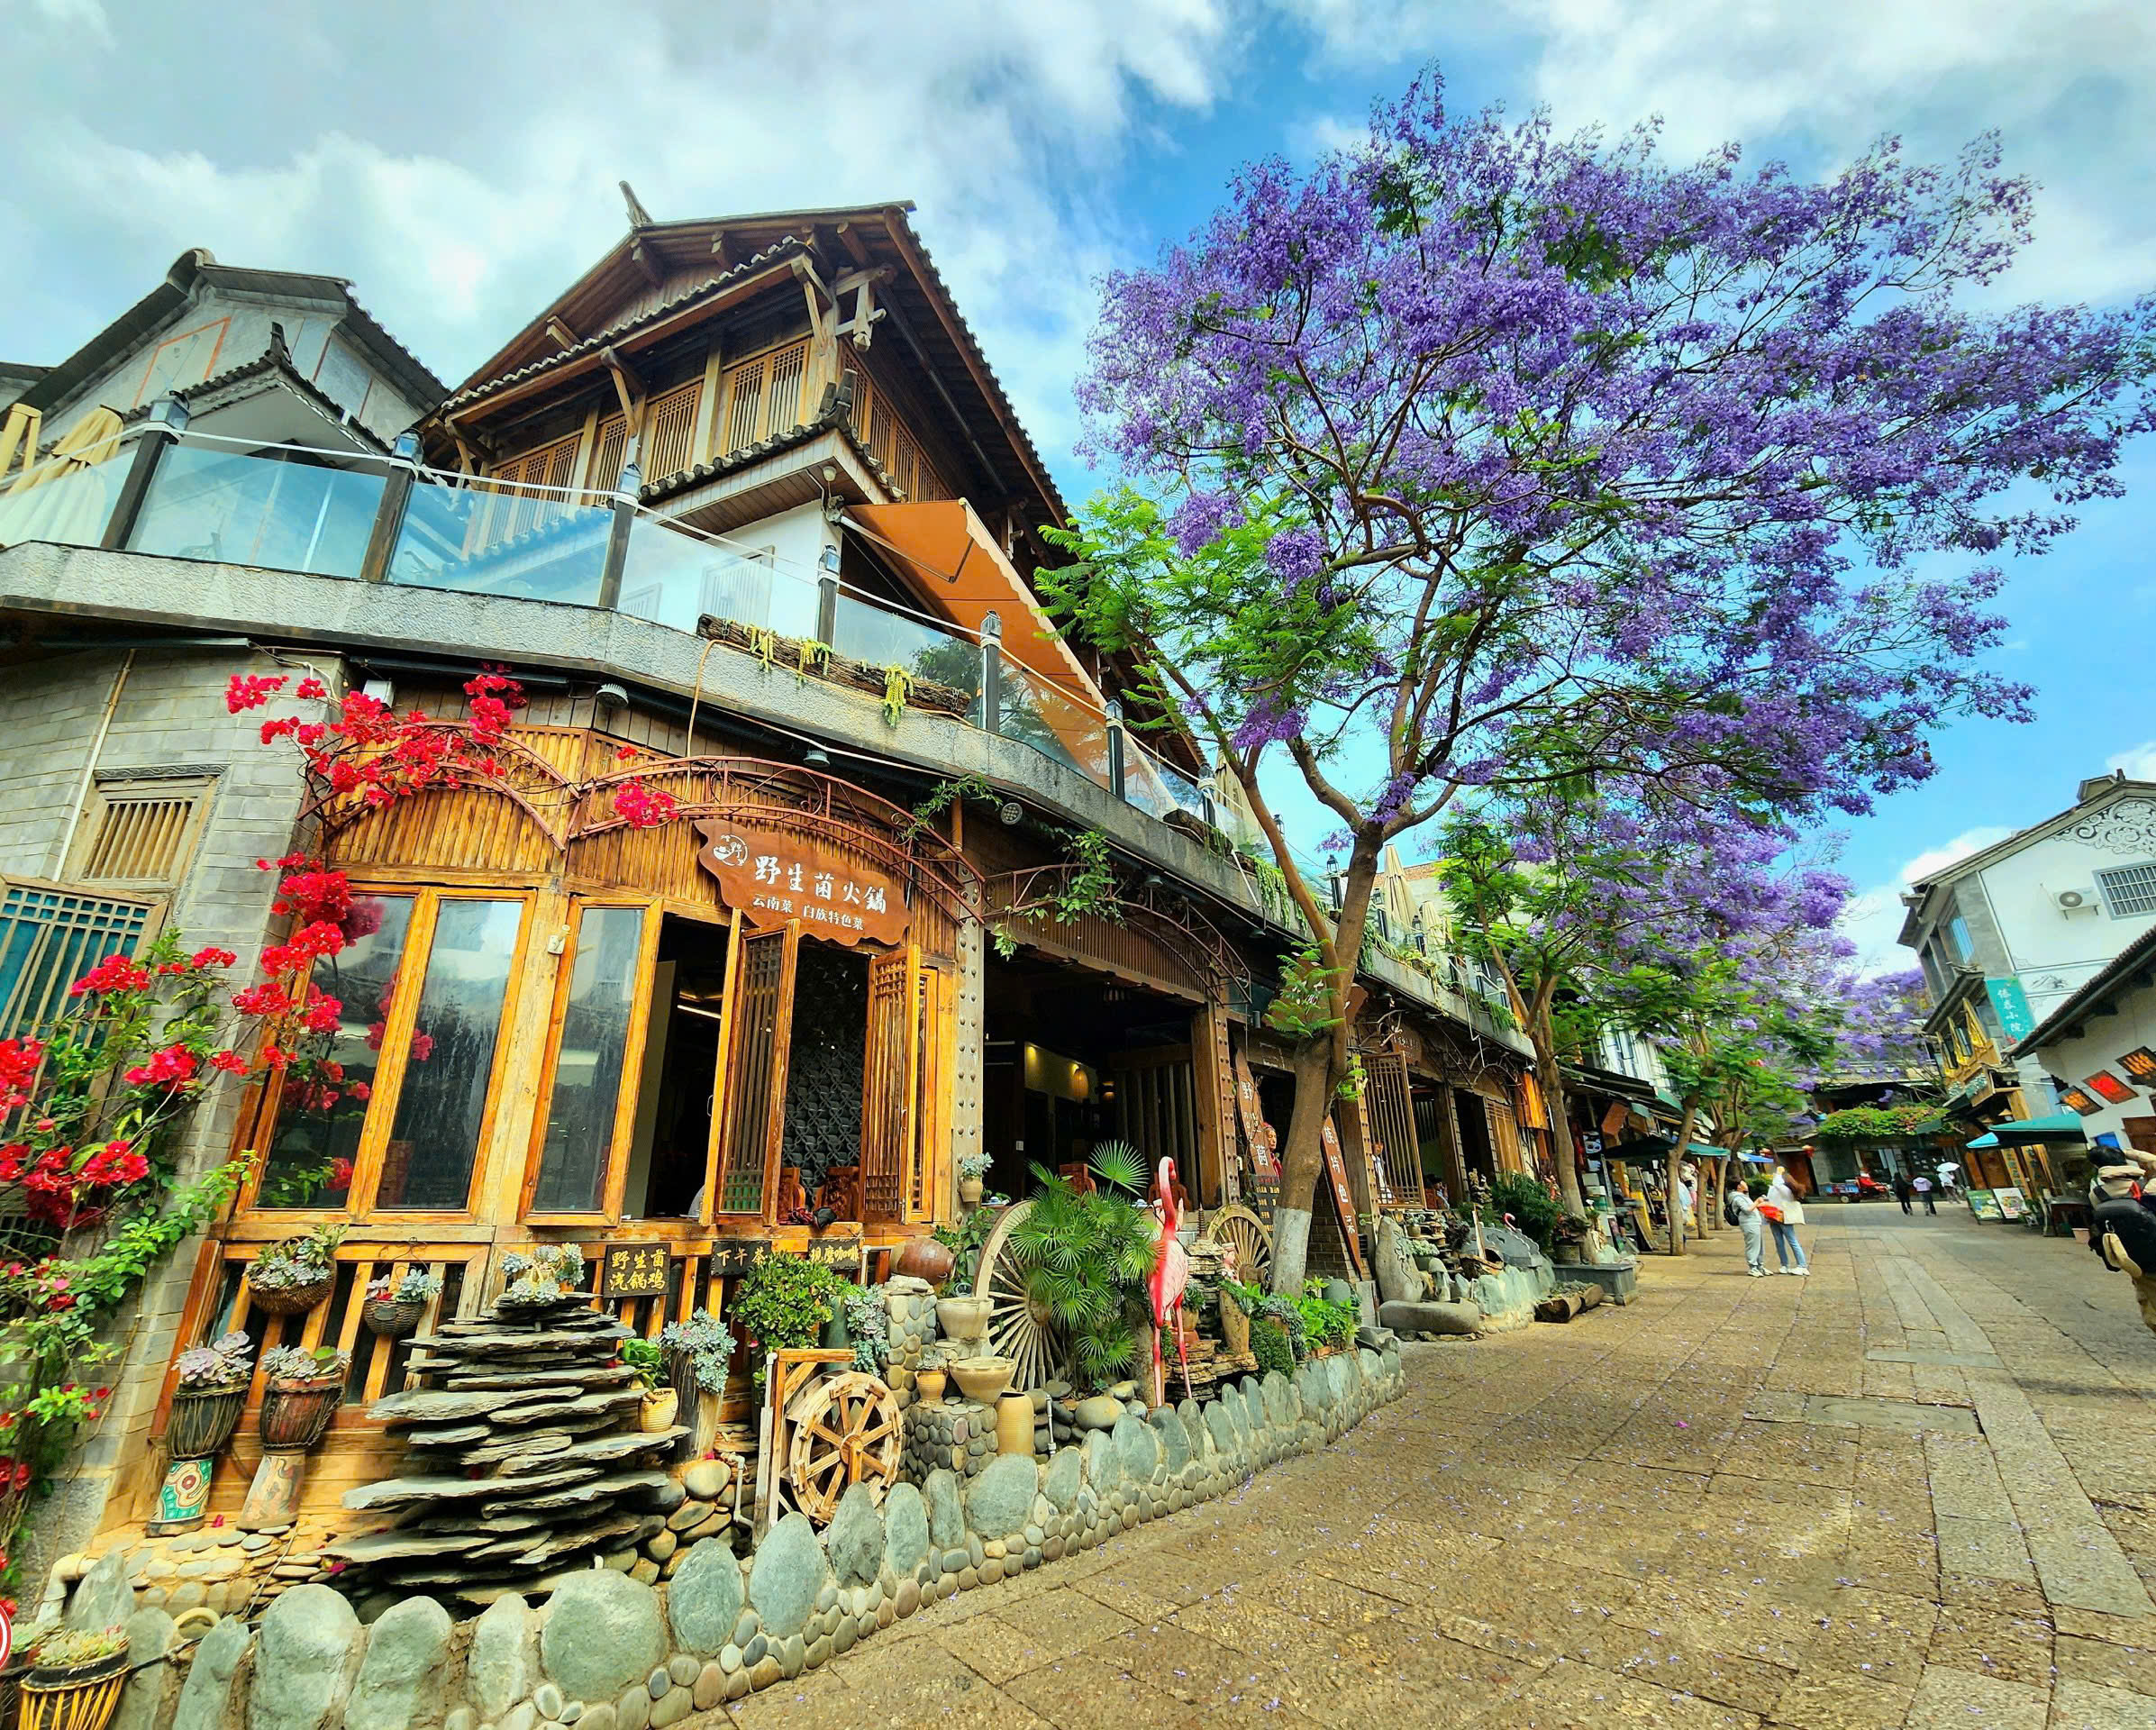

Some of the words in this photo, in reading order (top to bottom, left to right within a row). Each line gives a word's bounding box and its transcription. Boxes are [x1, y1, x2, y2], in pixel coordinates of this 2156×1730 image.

[752, 893, 793, 914] 云南菜
[803, 905, 864, 931] 白族特色菜
[612, 1248, 667, 1270] 野生菌
[716, 1245, 766, 1267] 下午茶
[810, 1244, 860, 1264] 现磨咖啡
